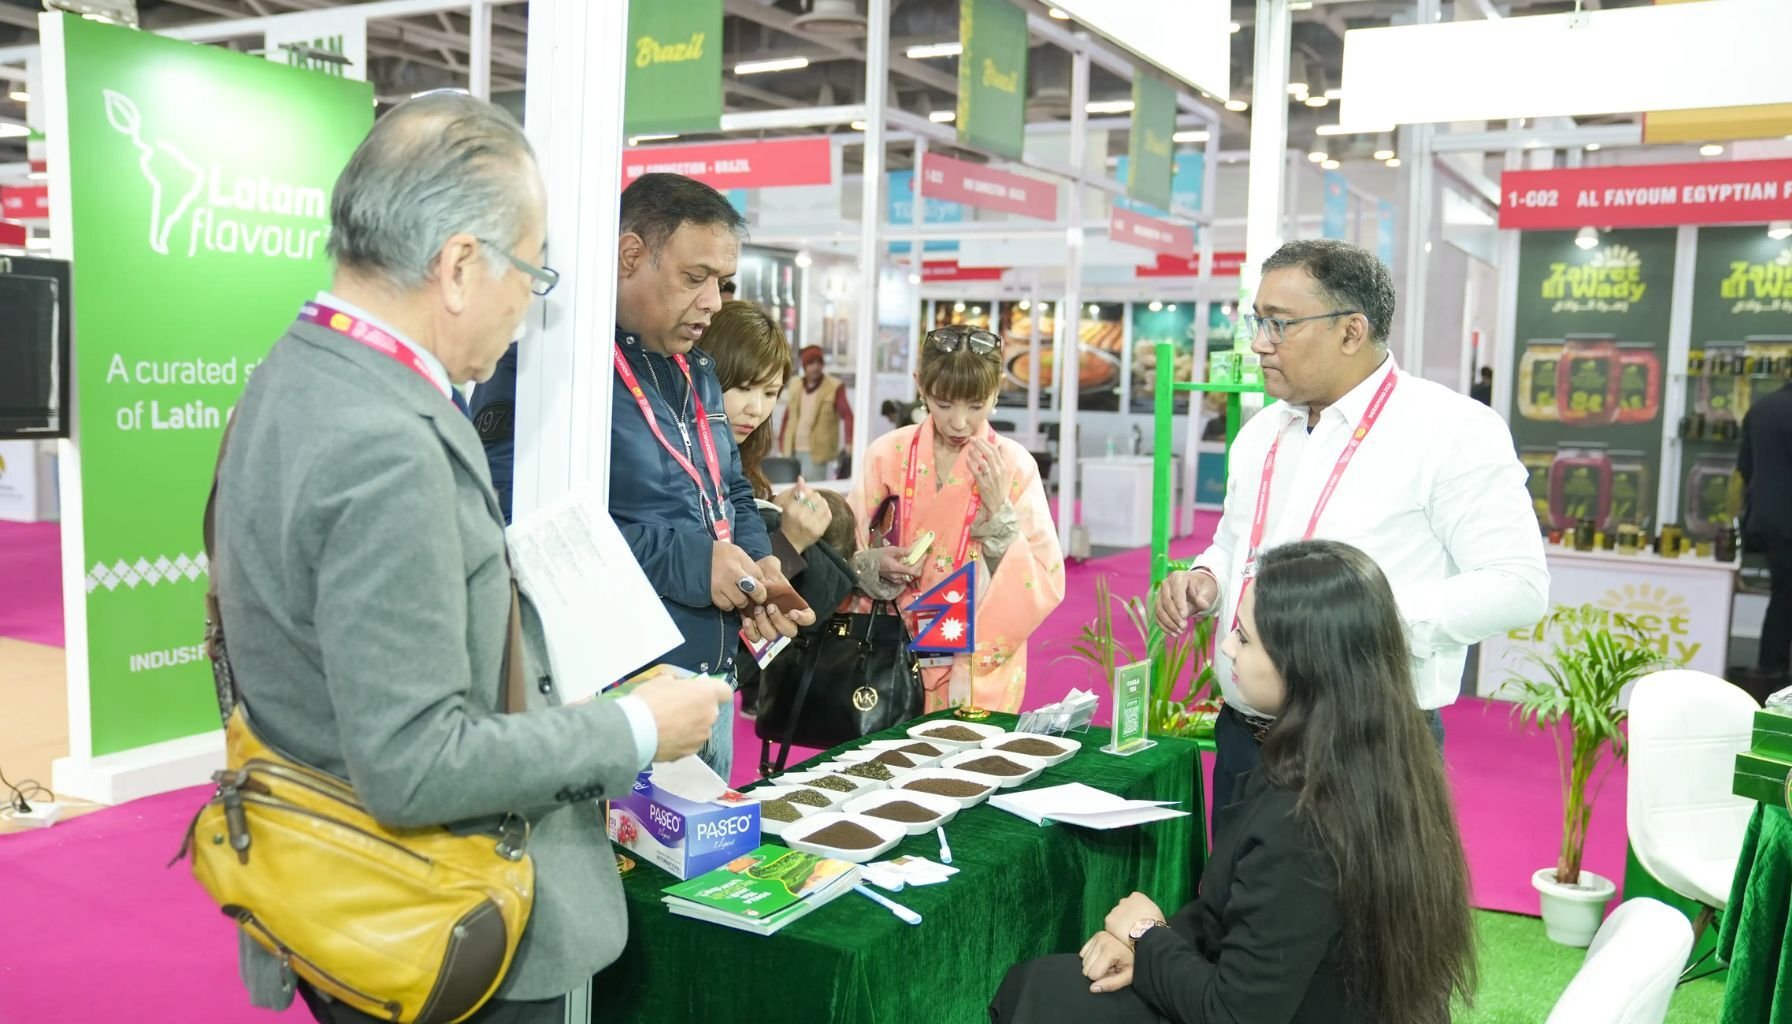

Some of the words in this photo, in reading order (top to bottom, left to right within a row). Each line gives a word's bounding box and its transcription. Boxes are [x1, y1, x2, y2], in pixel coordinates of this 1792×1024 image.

[636, 32, 704, 67] Brazil
[209, 164, 325, 219] Latam
[1577, 190, 1599, 208] AL
[1604, 187, 1676, 207] FAYOUM
[1683, 182, 1777, 204] EGYPTIAN
[1571, 279, 1647, 303] Wady
[106, 353, 130, 384] A
[136, 356, 237, 385] curated
[117, 400, 145, 430] of
[151, 400, 220, 430] Latin
[650, 804, 680, 833] PASEO
[697, 815, 750, 841] PASEO
